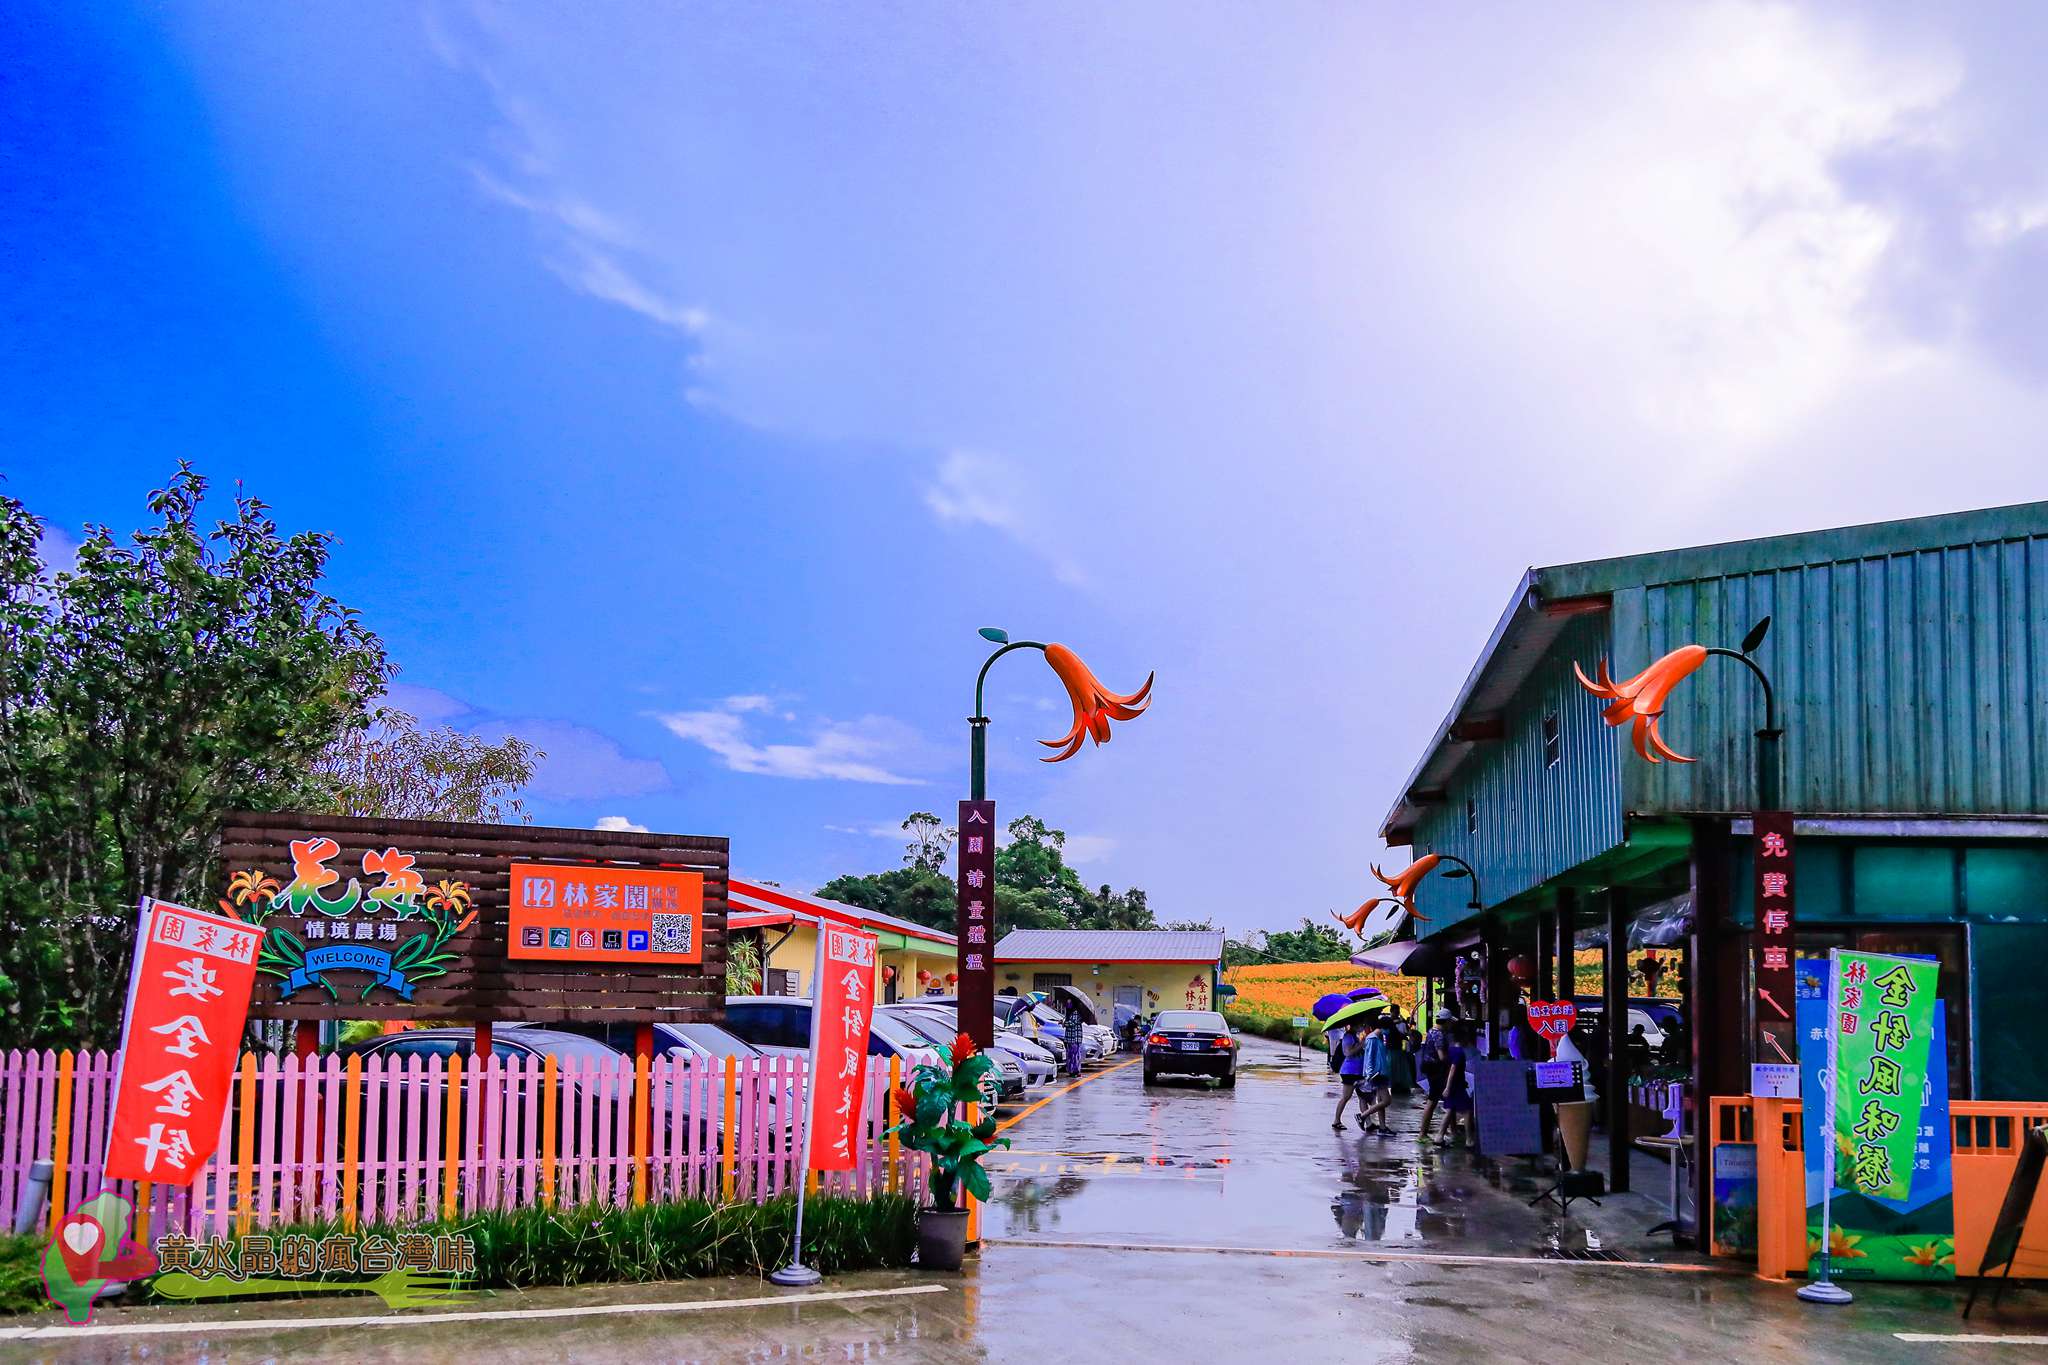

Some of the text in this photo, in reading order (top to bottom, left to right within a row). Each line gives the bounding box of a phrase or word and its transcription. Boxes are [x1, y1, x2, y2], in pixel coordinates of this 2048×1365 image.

[273, 837, 427, 921] 花海
[966, 809, 988, 971] 入園請量體溫
[562, 882, 649, 910] 林家園
[1761, 831, 1789, 971] 免費停車
[305, 921, 398, 942] 情境農場
[311, 952, 385, 968] WELCOME
[1537, 1019, 1569, 1034] 入園
